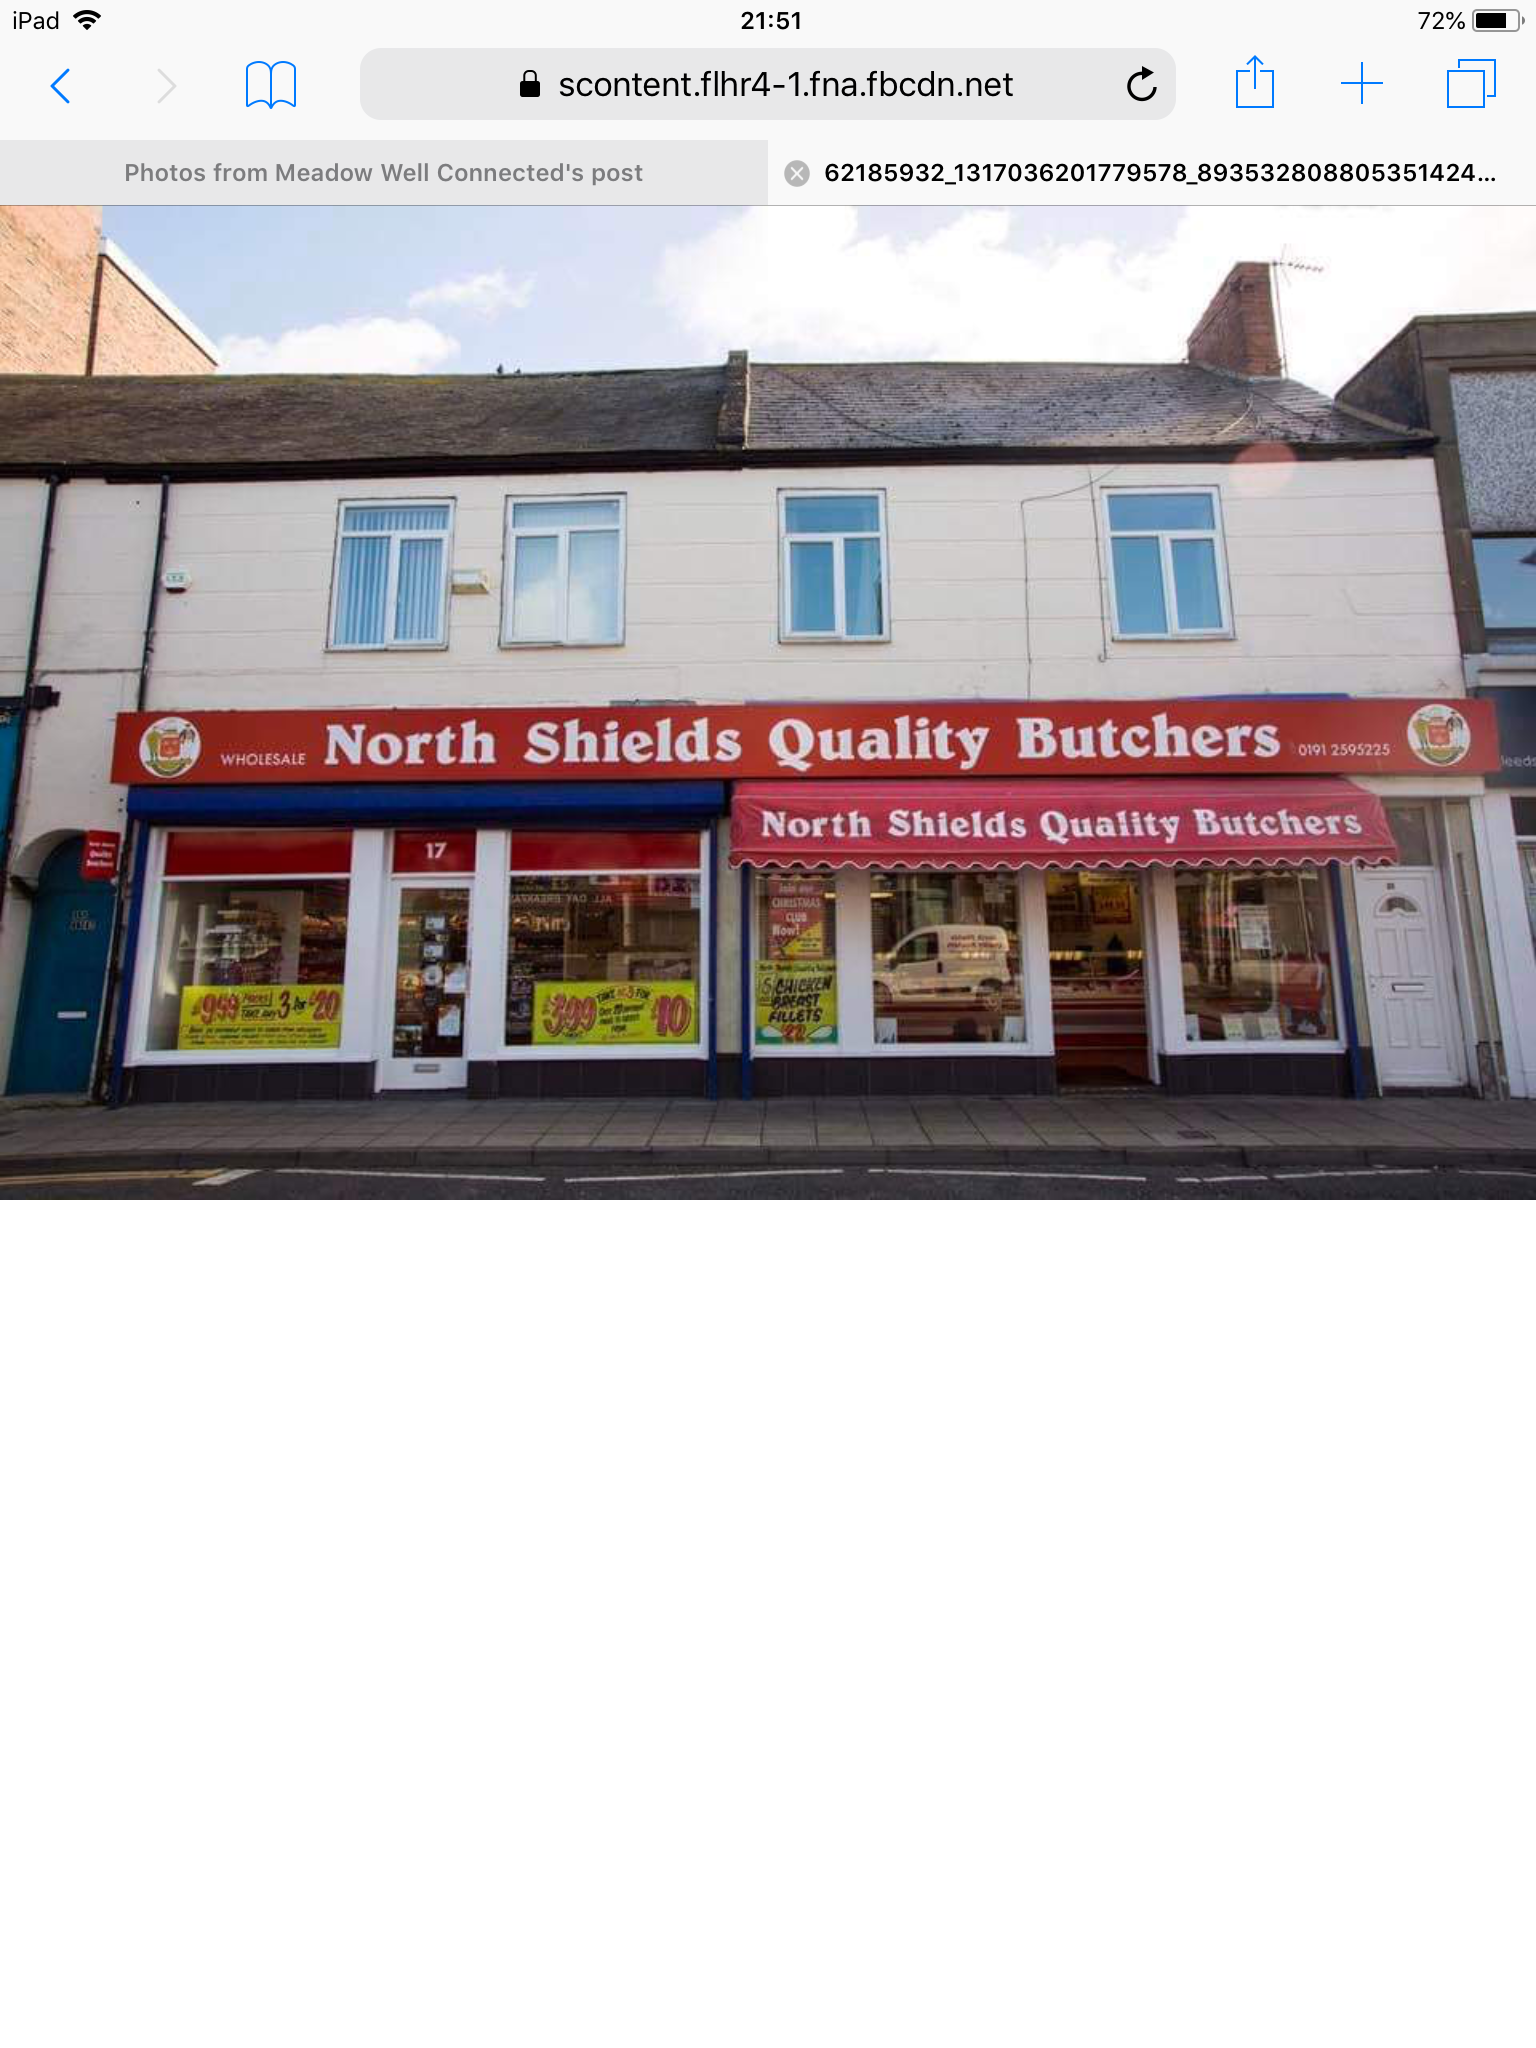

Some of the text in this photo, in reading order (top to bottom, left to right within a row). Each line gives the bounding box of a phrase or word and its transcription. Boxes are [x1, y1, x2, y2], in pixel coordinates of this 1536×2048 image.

[219, 714, 1391, 772] WHOLESALE North Shields Quality Butchers 0191 2595225
[760, 808, 1363, 845] North Shields Quality Butchers
[425, 842, 447, 860] 17
[772, 897, 821, 908] CHRISTMAS
[785, 911, 807, 922] CLUB
[772, 922, 800, 936] Now!
[775, 974, 833, 995] CHICKEN
[773, 993, 820, 1009] BREAST
[768, 1008, 823, 1023] FILLETS
